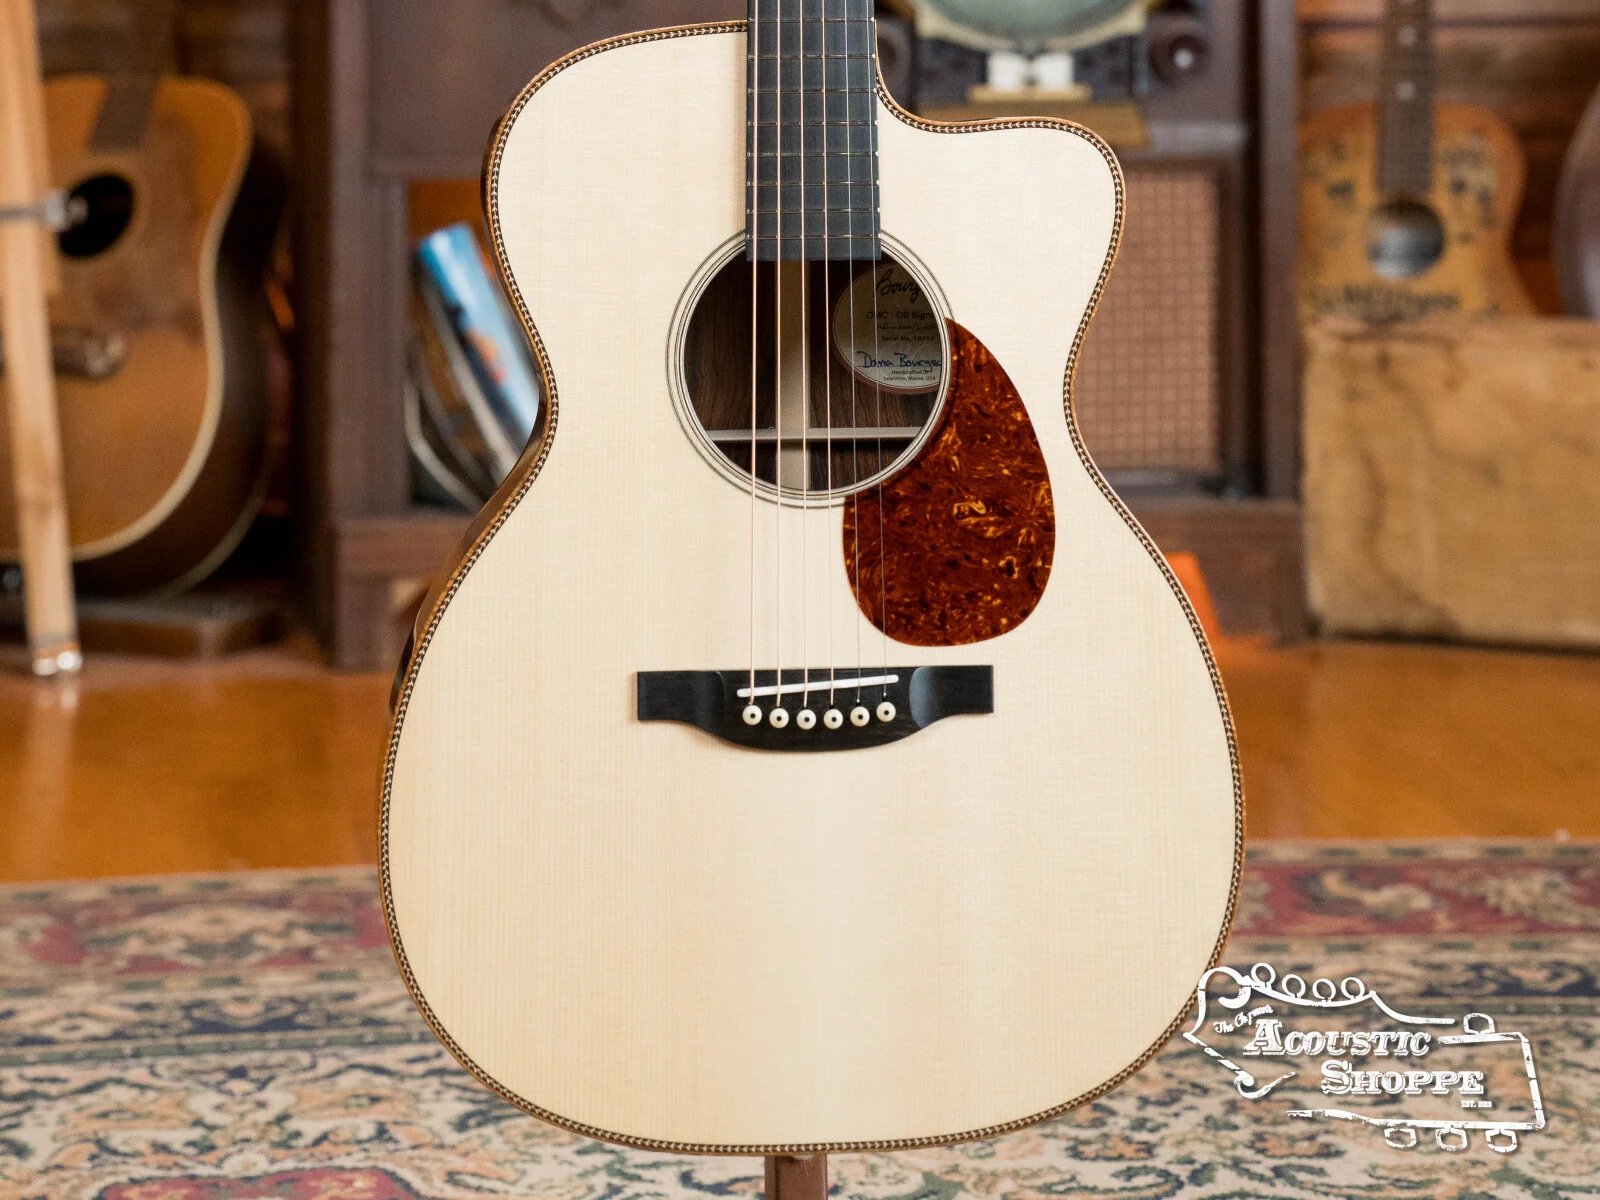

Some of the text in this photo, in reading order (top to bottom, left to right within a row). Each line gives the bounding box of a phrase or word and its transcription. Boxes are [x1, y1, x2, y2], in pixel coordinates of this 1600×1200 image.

[873, 267, 921, 304] Bourg
[896, 310, 910, 319] DB
[911, 310, 935, 321] Signa
[857, 350, 894, 368] Dana
